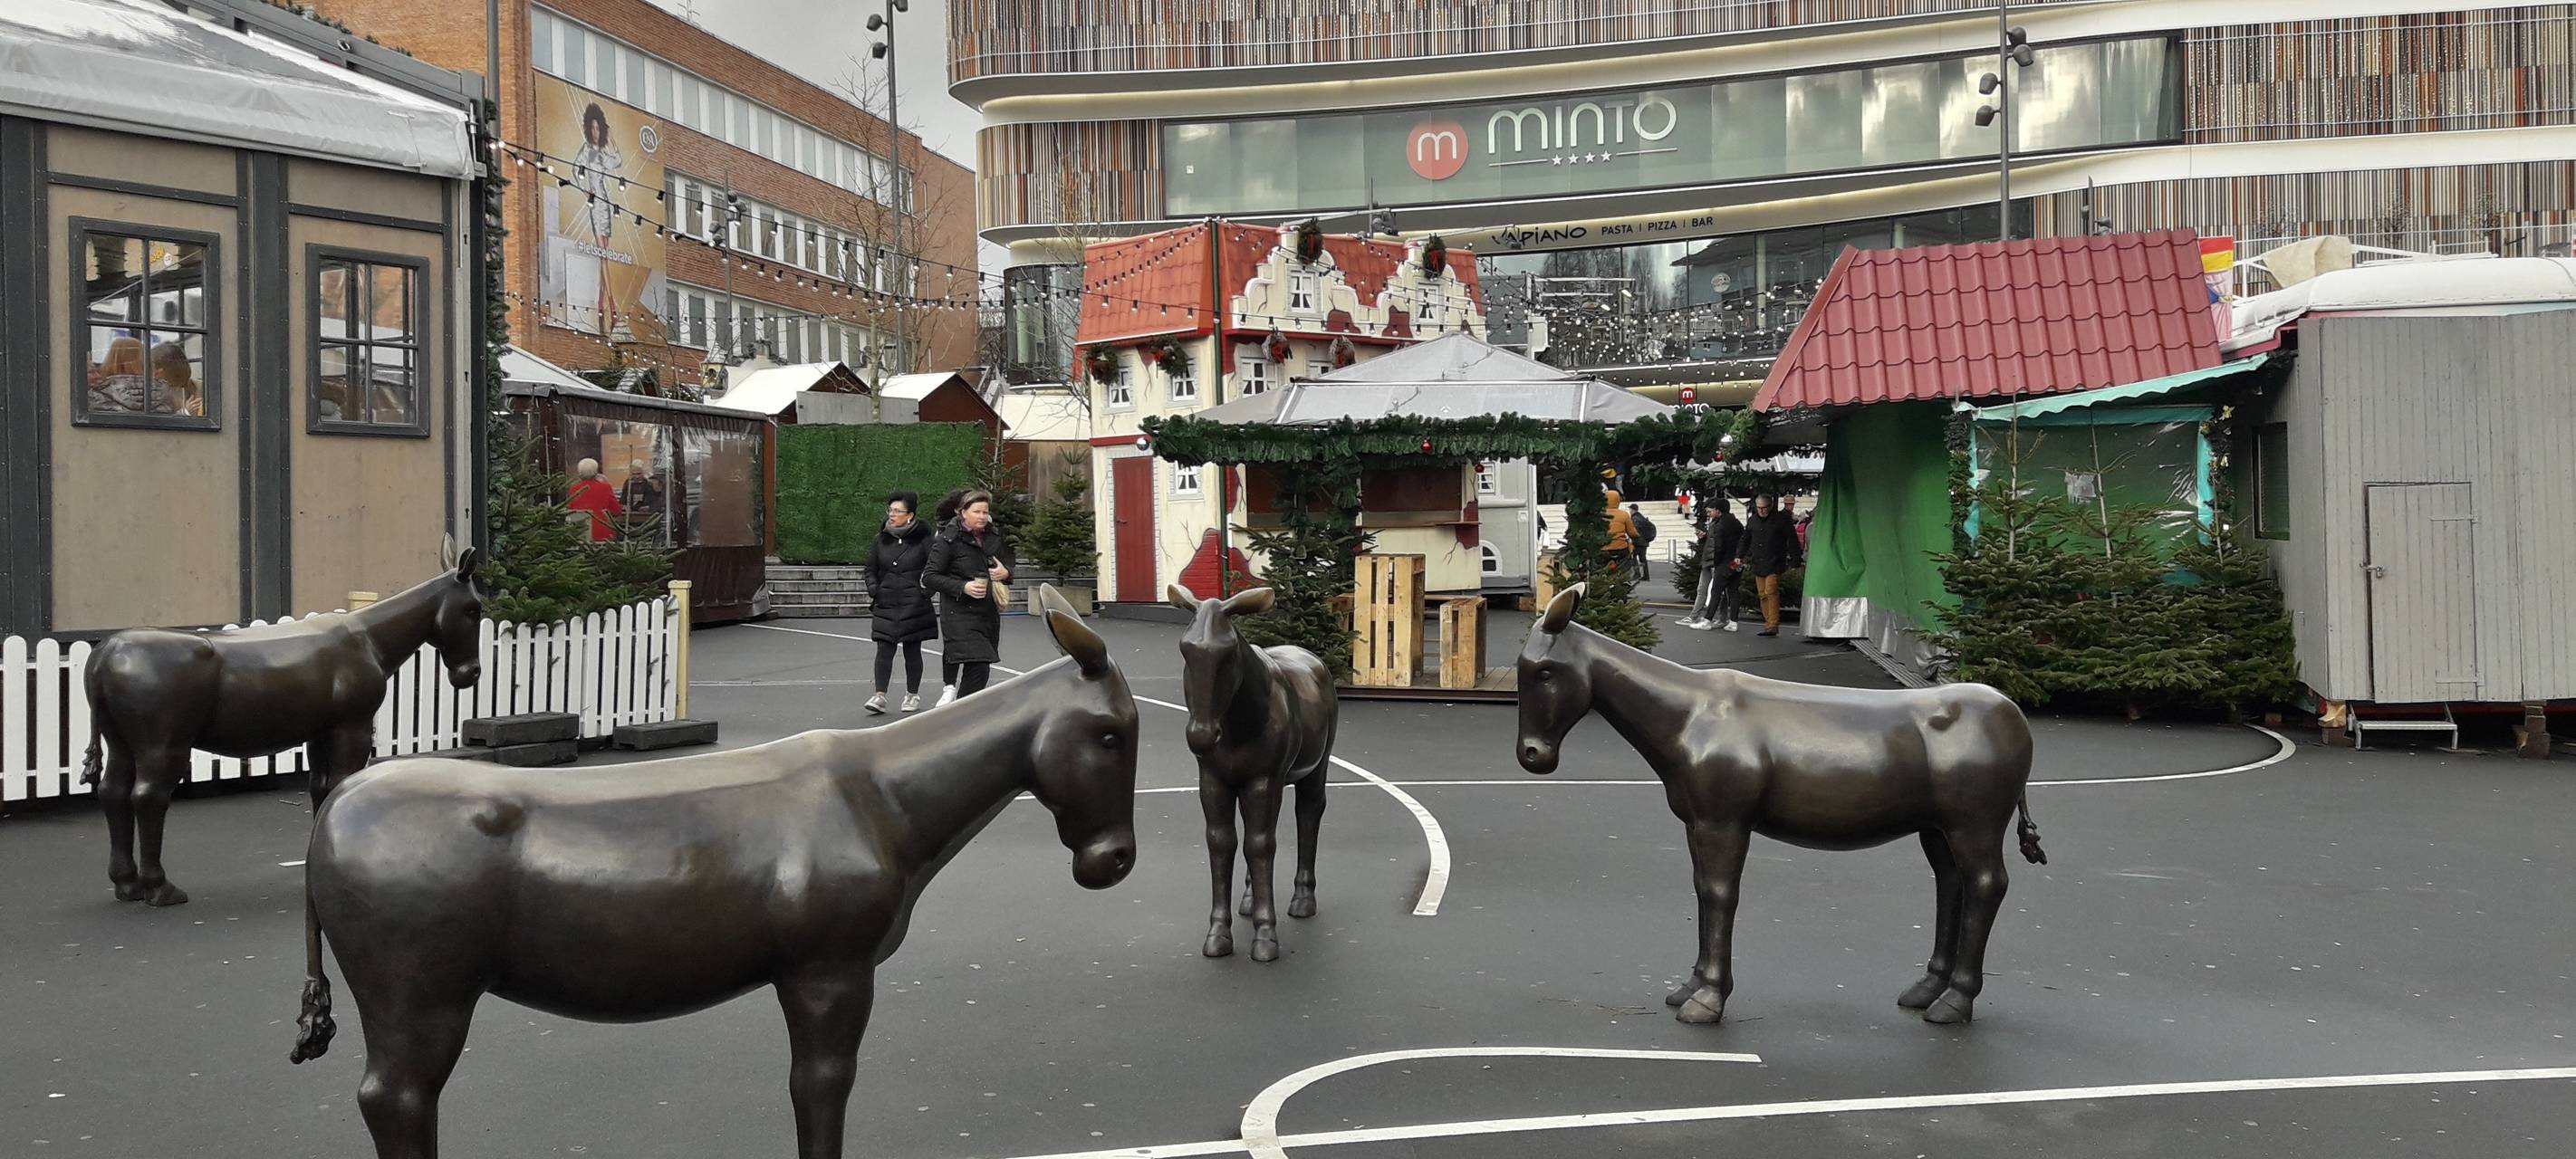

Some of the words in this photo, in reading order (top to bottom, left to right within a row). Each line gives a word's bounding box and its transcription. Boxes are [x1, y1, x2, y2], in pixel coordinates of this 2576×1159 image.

[1601, 224, 1633, 235] PASTA
[1648, 220, 1677, 232] PIZZA
[1691, 216, 1714, 227] BAR
[578, 240, 632, 264] #letscelebrate
